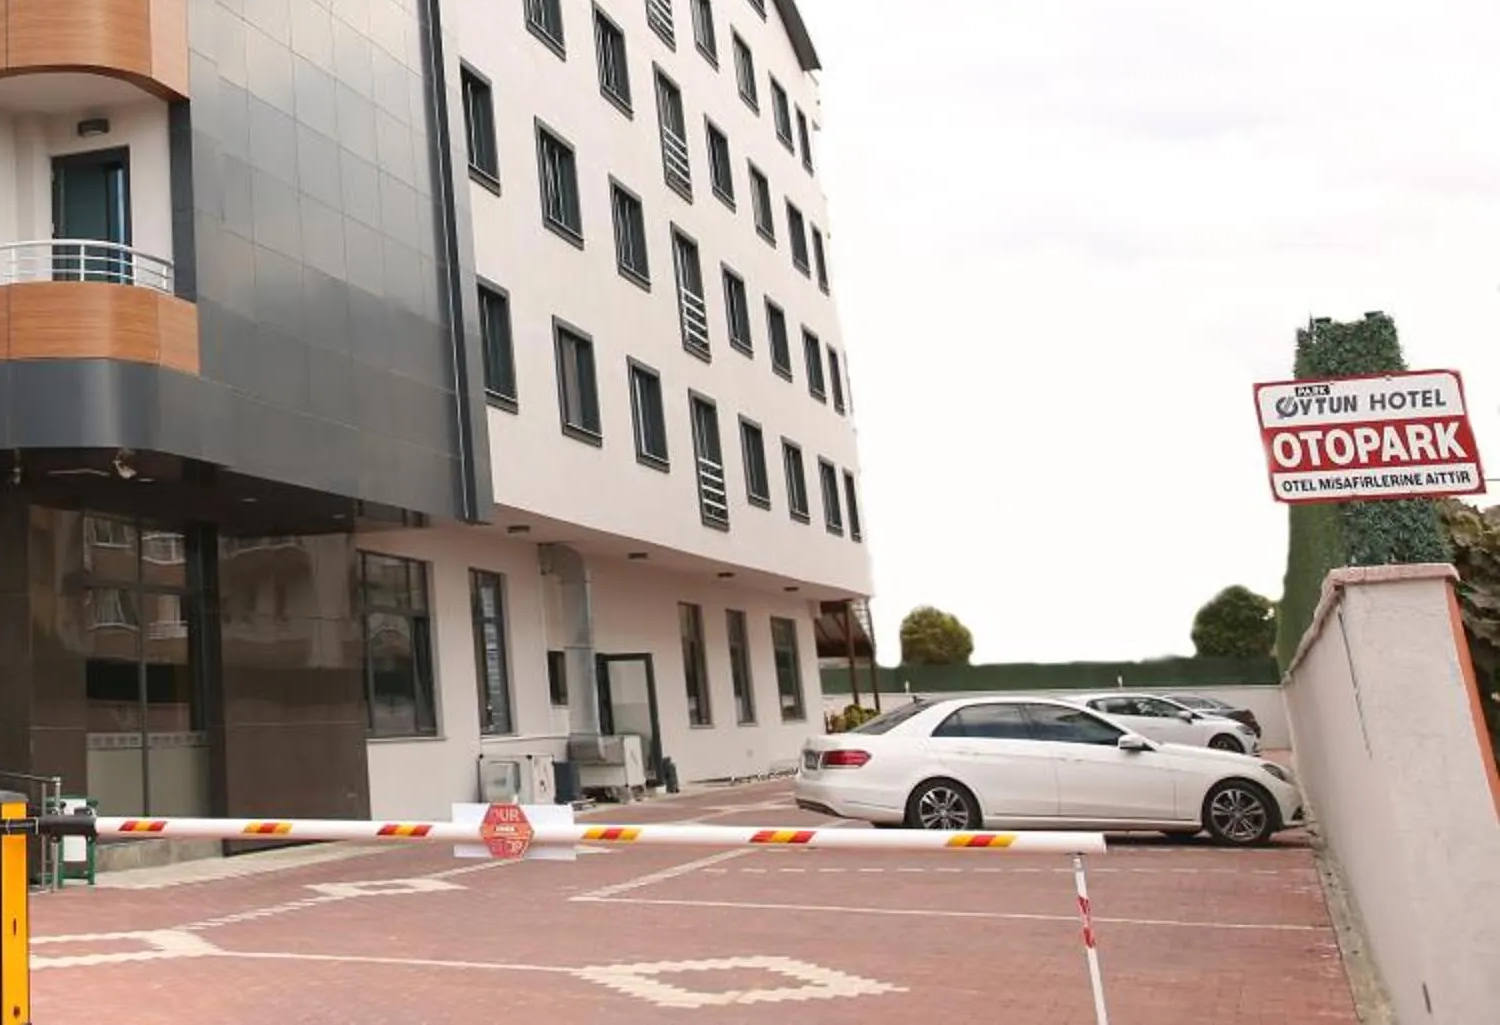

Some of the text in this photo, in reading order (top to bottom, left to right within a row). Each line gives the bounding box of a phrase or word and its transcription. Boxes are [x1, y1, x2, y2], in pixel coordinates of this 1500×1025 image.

[1369, 388, 1447, 411] HOTEL
[1272, 421, 1468, 468] OTOPARK
[1282, 478, 1316, 493] OTEL
